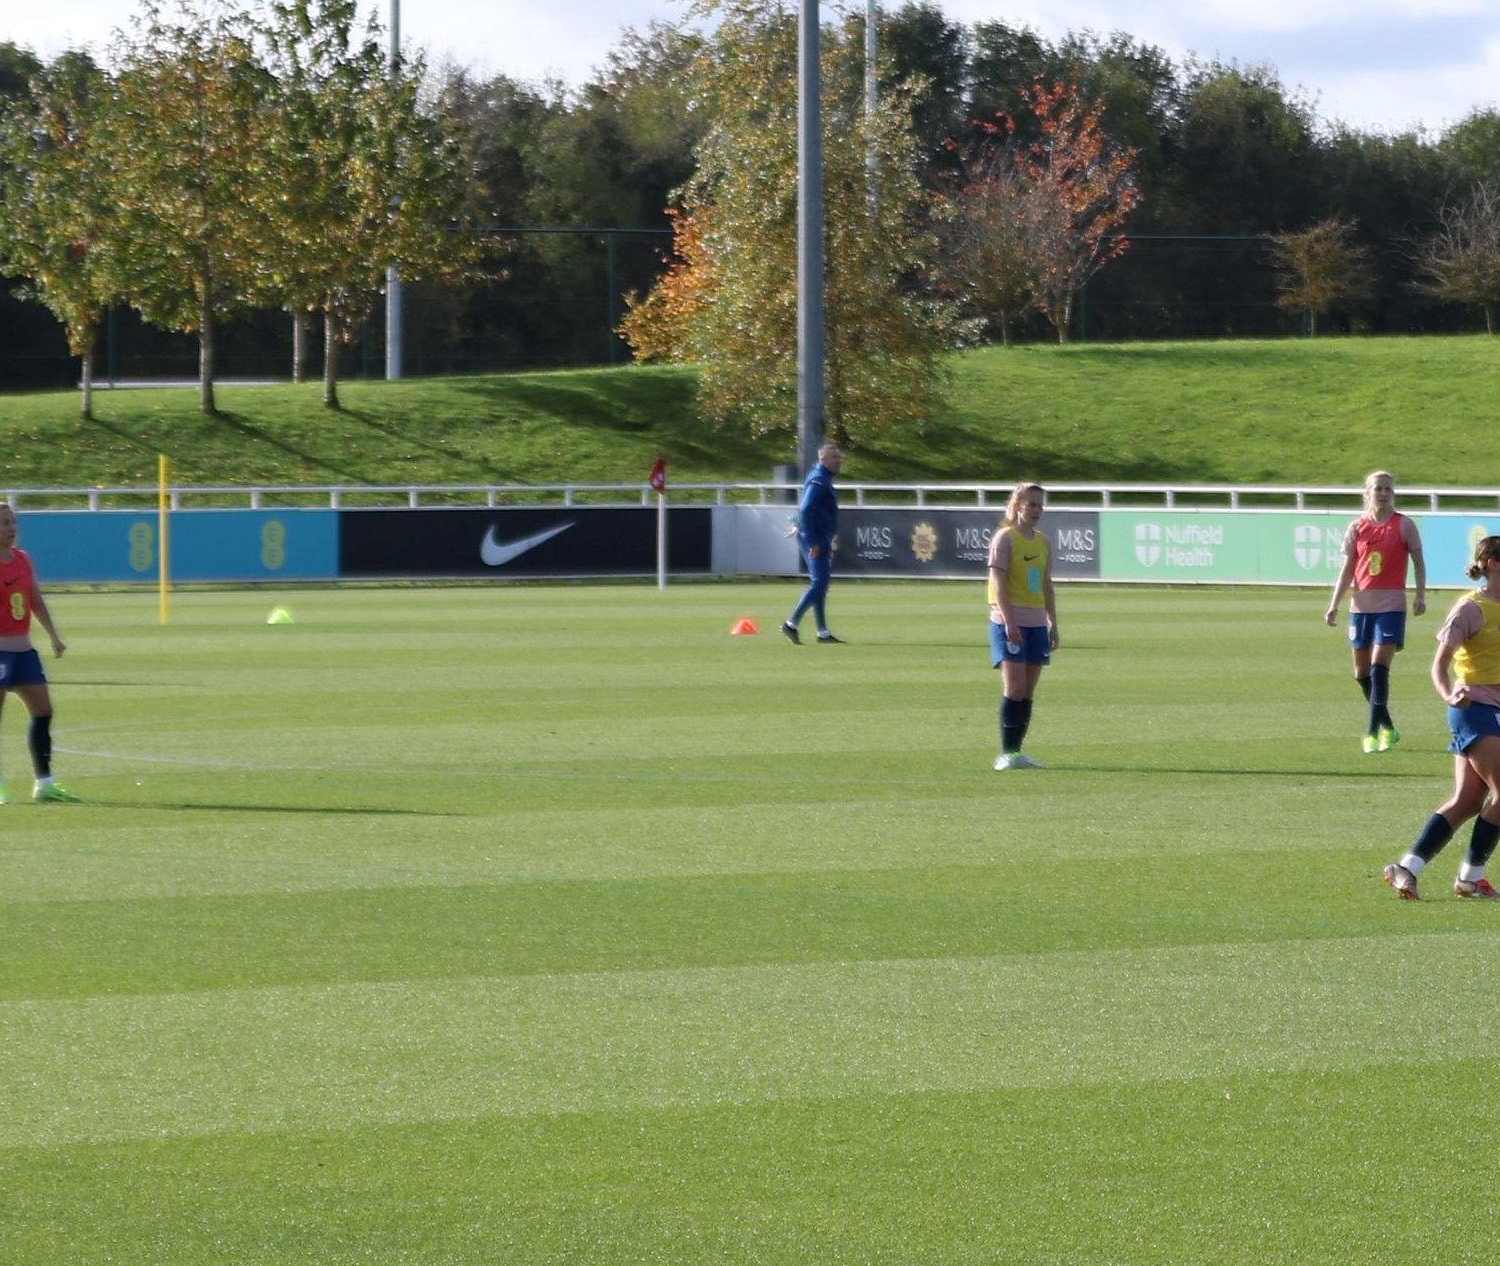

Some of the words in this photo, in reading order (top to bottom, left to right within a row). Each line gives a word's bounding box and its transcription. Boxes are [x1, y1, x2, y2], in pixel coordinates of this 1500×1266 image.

[856, 526, 892, 548] M&S
[956, 526, 992, 549] M&S
[1058, 528, 1095, 551] M&S
[1165, 525, 1223, 545] Nuffield
[1165, 546, 1214, 567] Health
